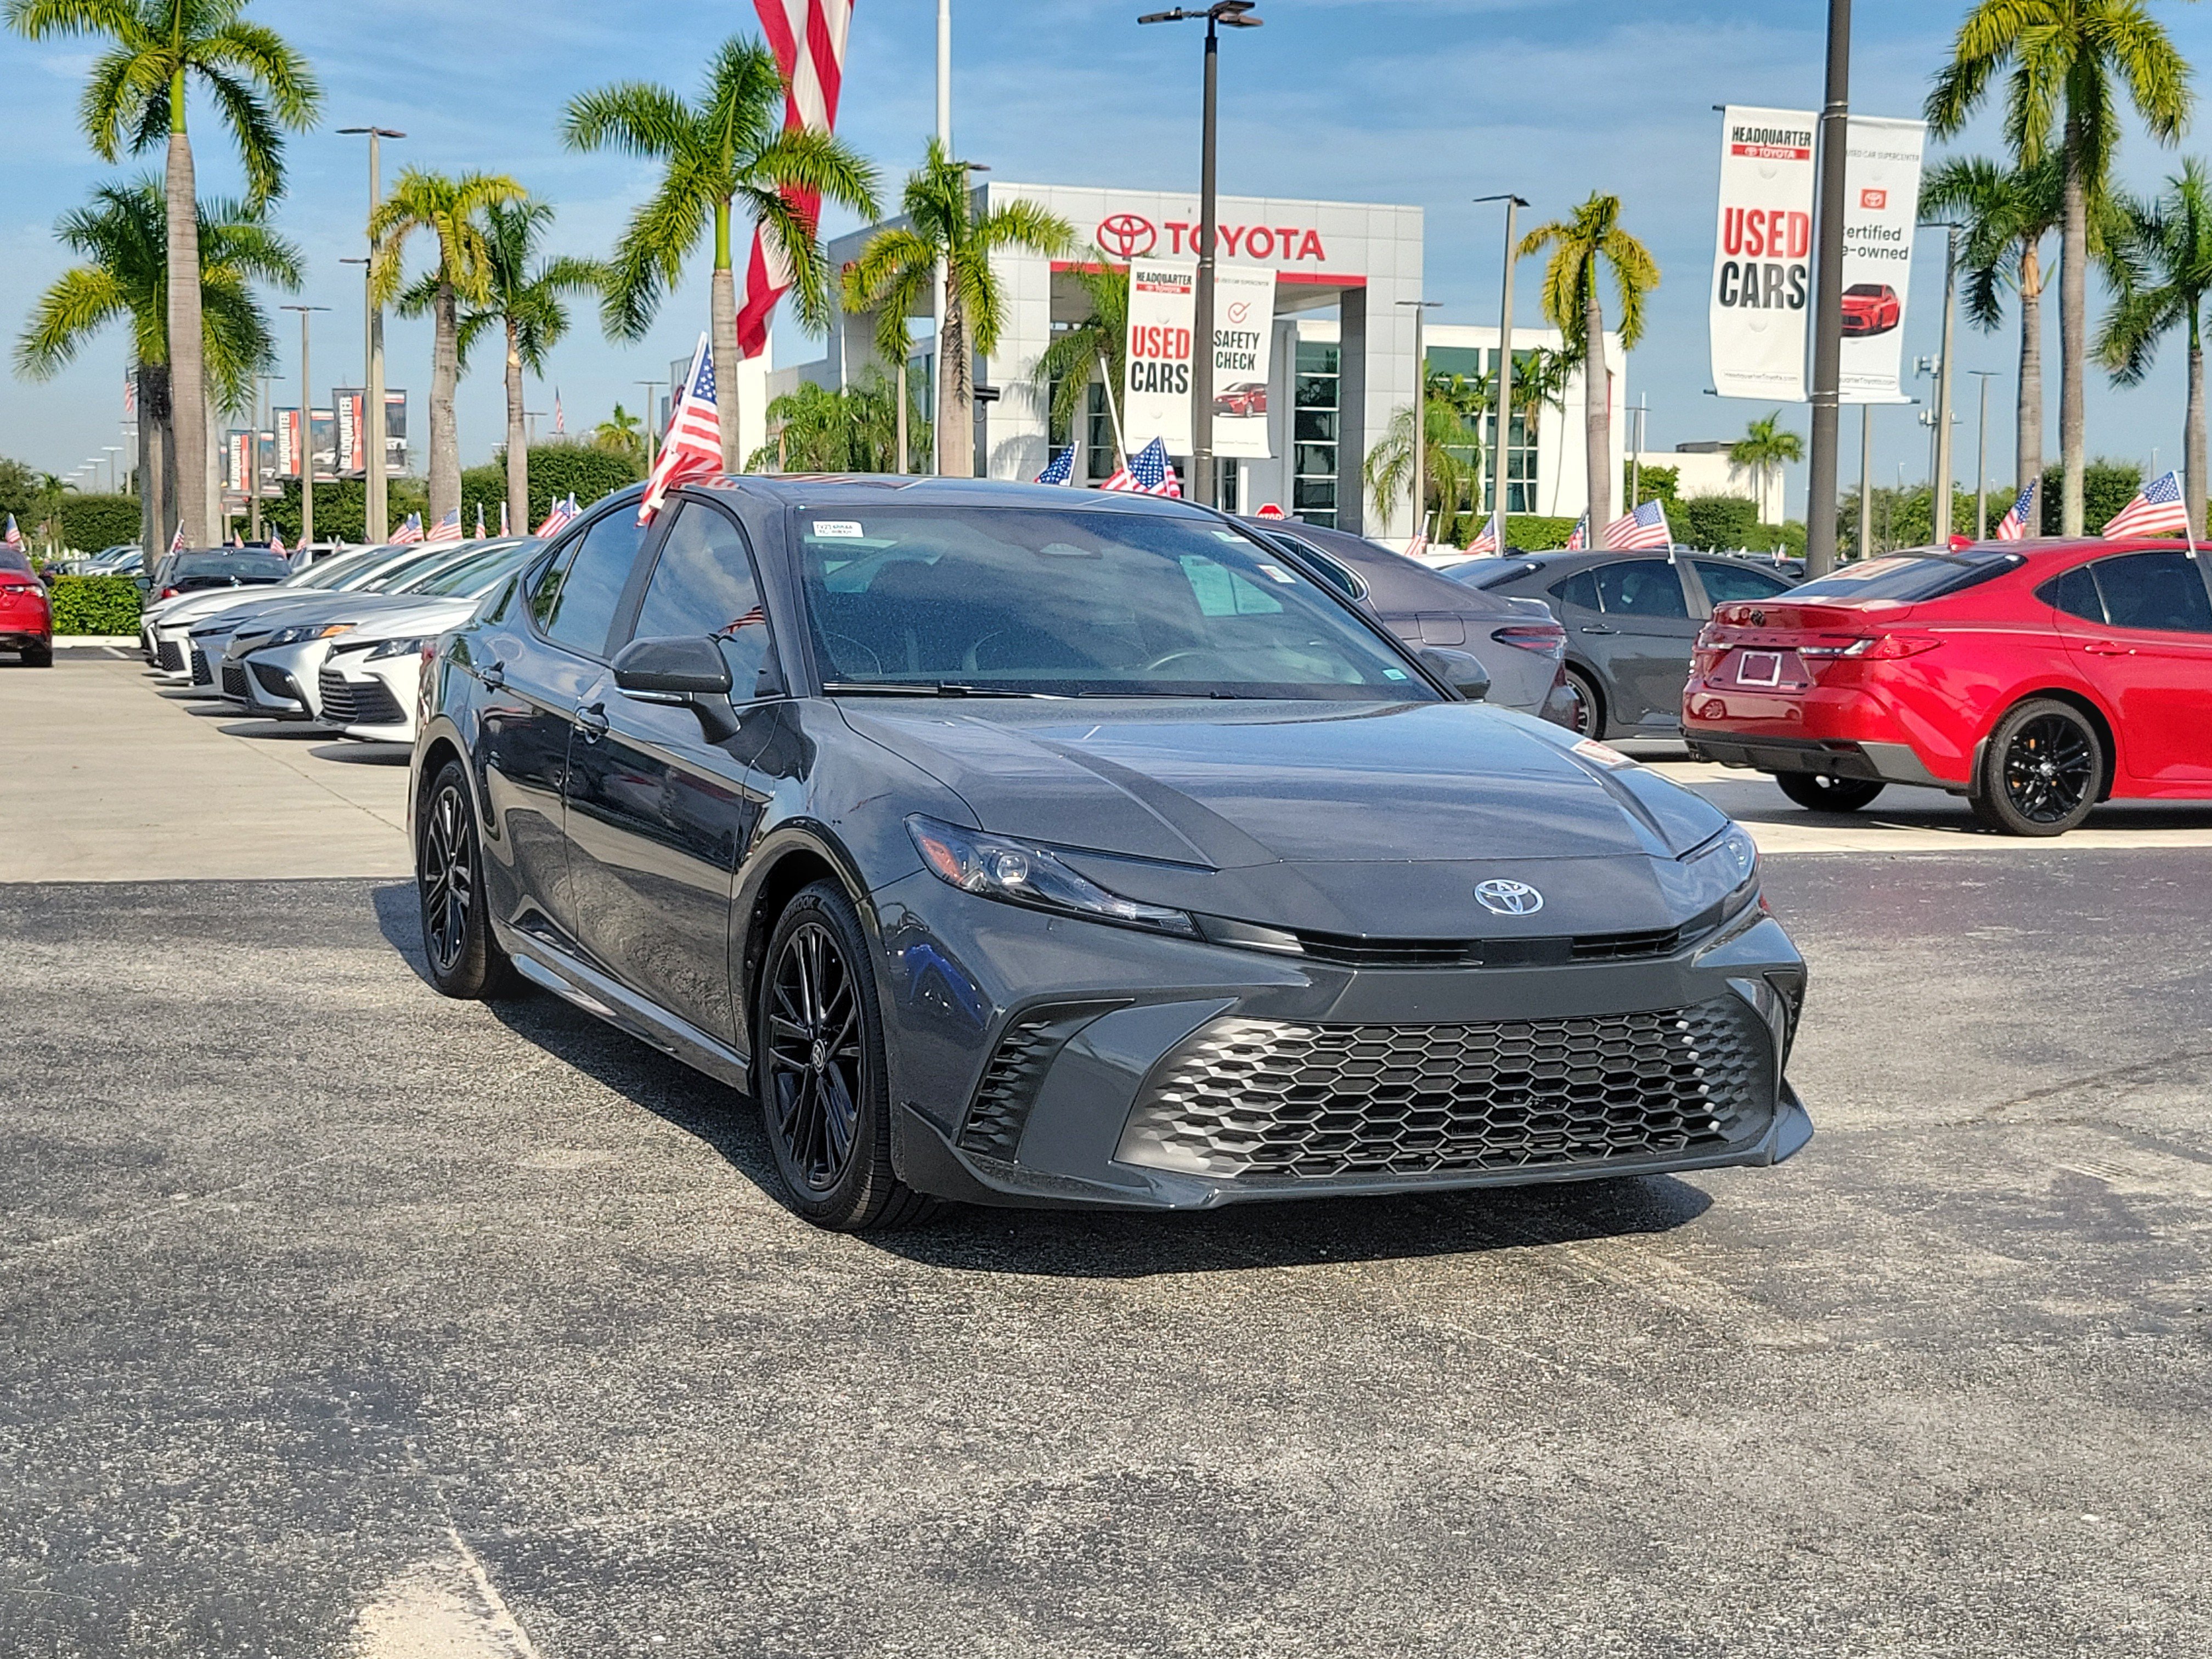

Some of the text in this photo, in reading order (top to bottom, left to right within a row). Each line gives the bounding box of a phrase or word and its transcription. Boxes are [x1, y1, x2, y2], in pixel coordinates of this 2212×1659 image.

[1732, 126, 1811, 148] HEADQUARTER
[1759, 148, 1796, 159] TOYOTA
[1165, 222, 1325, 261] TOYOTA
[1723, 207, 1809, 258] USED
[1844, 224, 1901, 241] ertified
[1842, 246, 1909, 260] e-owned
[1137, 272, 1192, 286] HEADQUARTER
[1718, 261, 1805, 309] CARS
[1132, 325, 1190, 360] USED
[1213, 330, 1260, 349] SAFETY
[1216, 351, 1256, 370] CHECK
[1131, 361, 1189, 394] CARS
[278, 412, 292, 475] HEADQUARTER
[340, 397, 354, 469] HEADQUARTER
